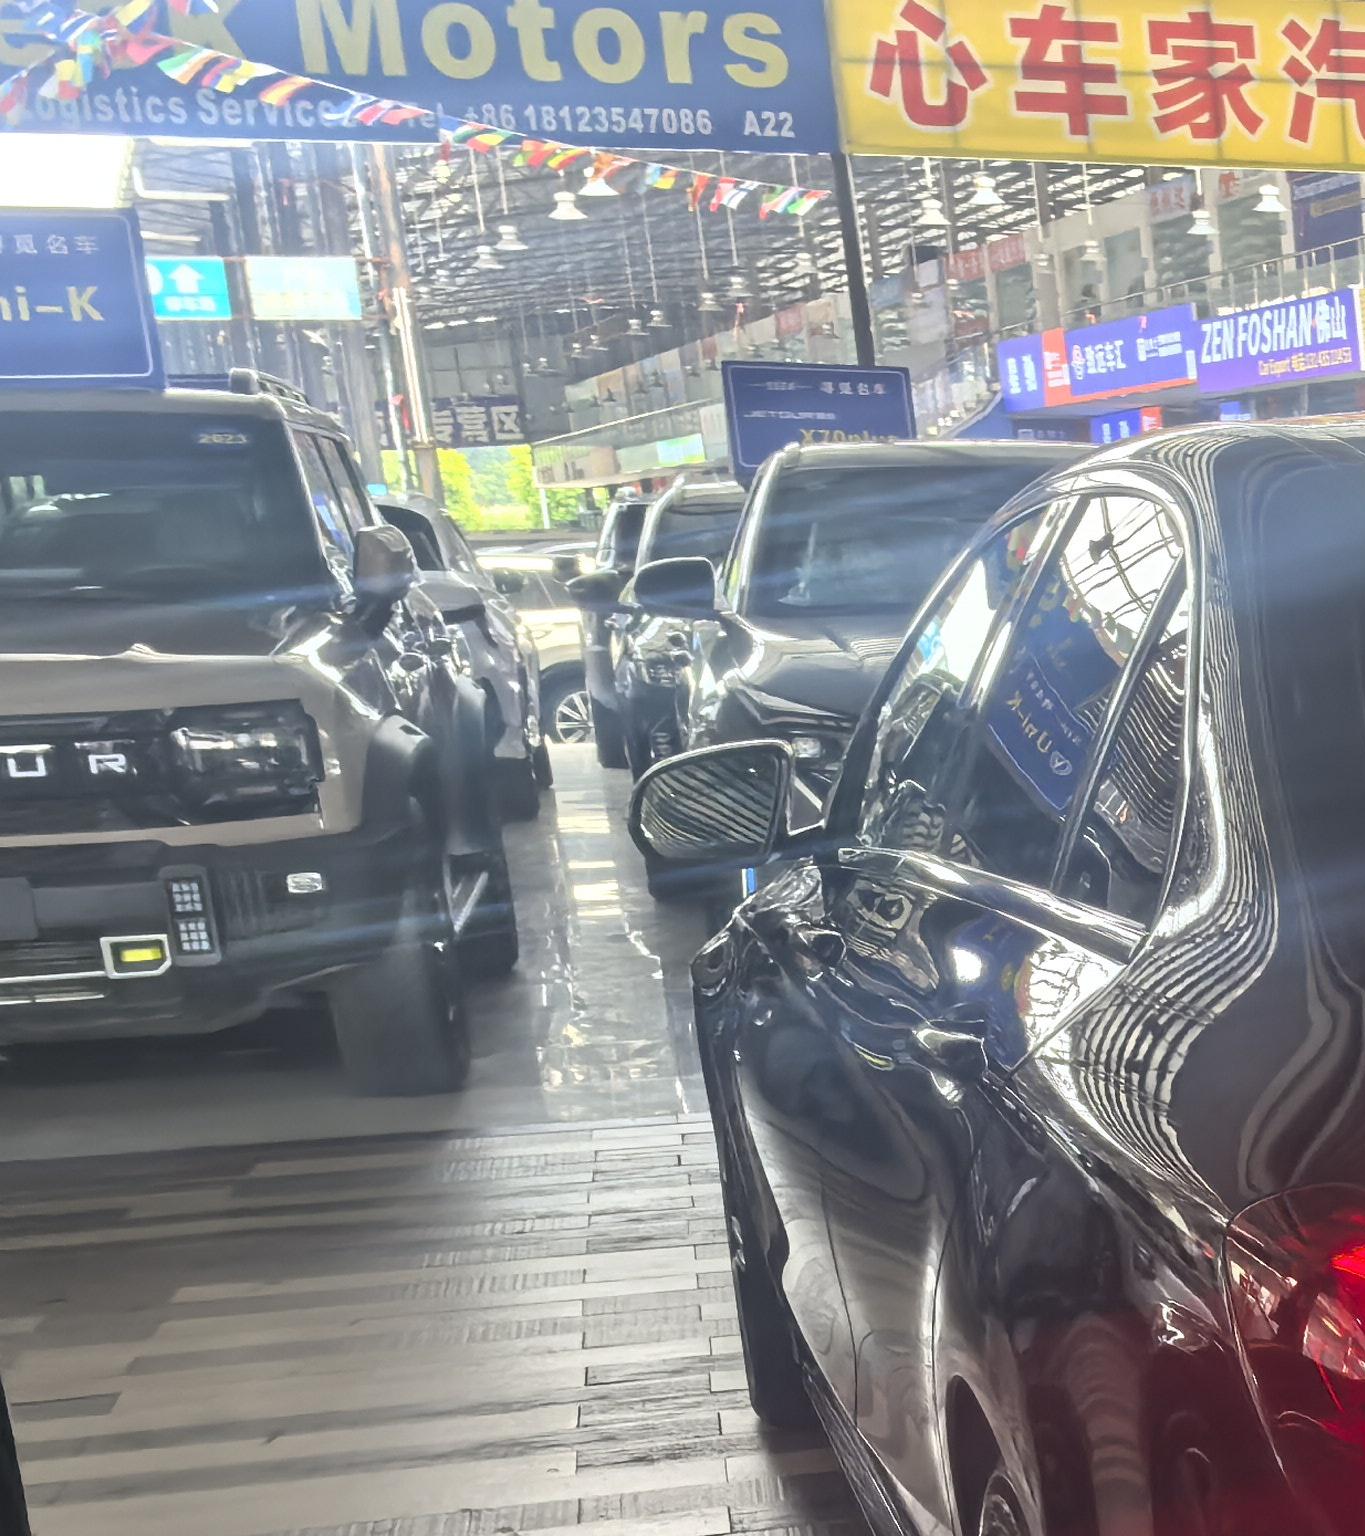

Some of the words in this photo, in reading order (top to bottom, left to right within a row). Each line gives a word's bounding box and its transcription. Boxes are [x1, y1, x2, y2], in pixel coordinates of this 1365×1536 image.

[297, 0, 789, 88] Motors
[523, 104, 713, 135] 18123547086
[744, 110, 795, 138] A22
[1201, 318, 1234, 364] ZEN
[1237, 301, 1312, 358] FOSHAN
